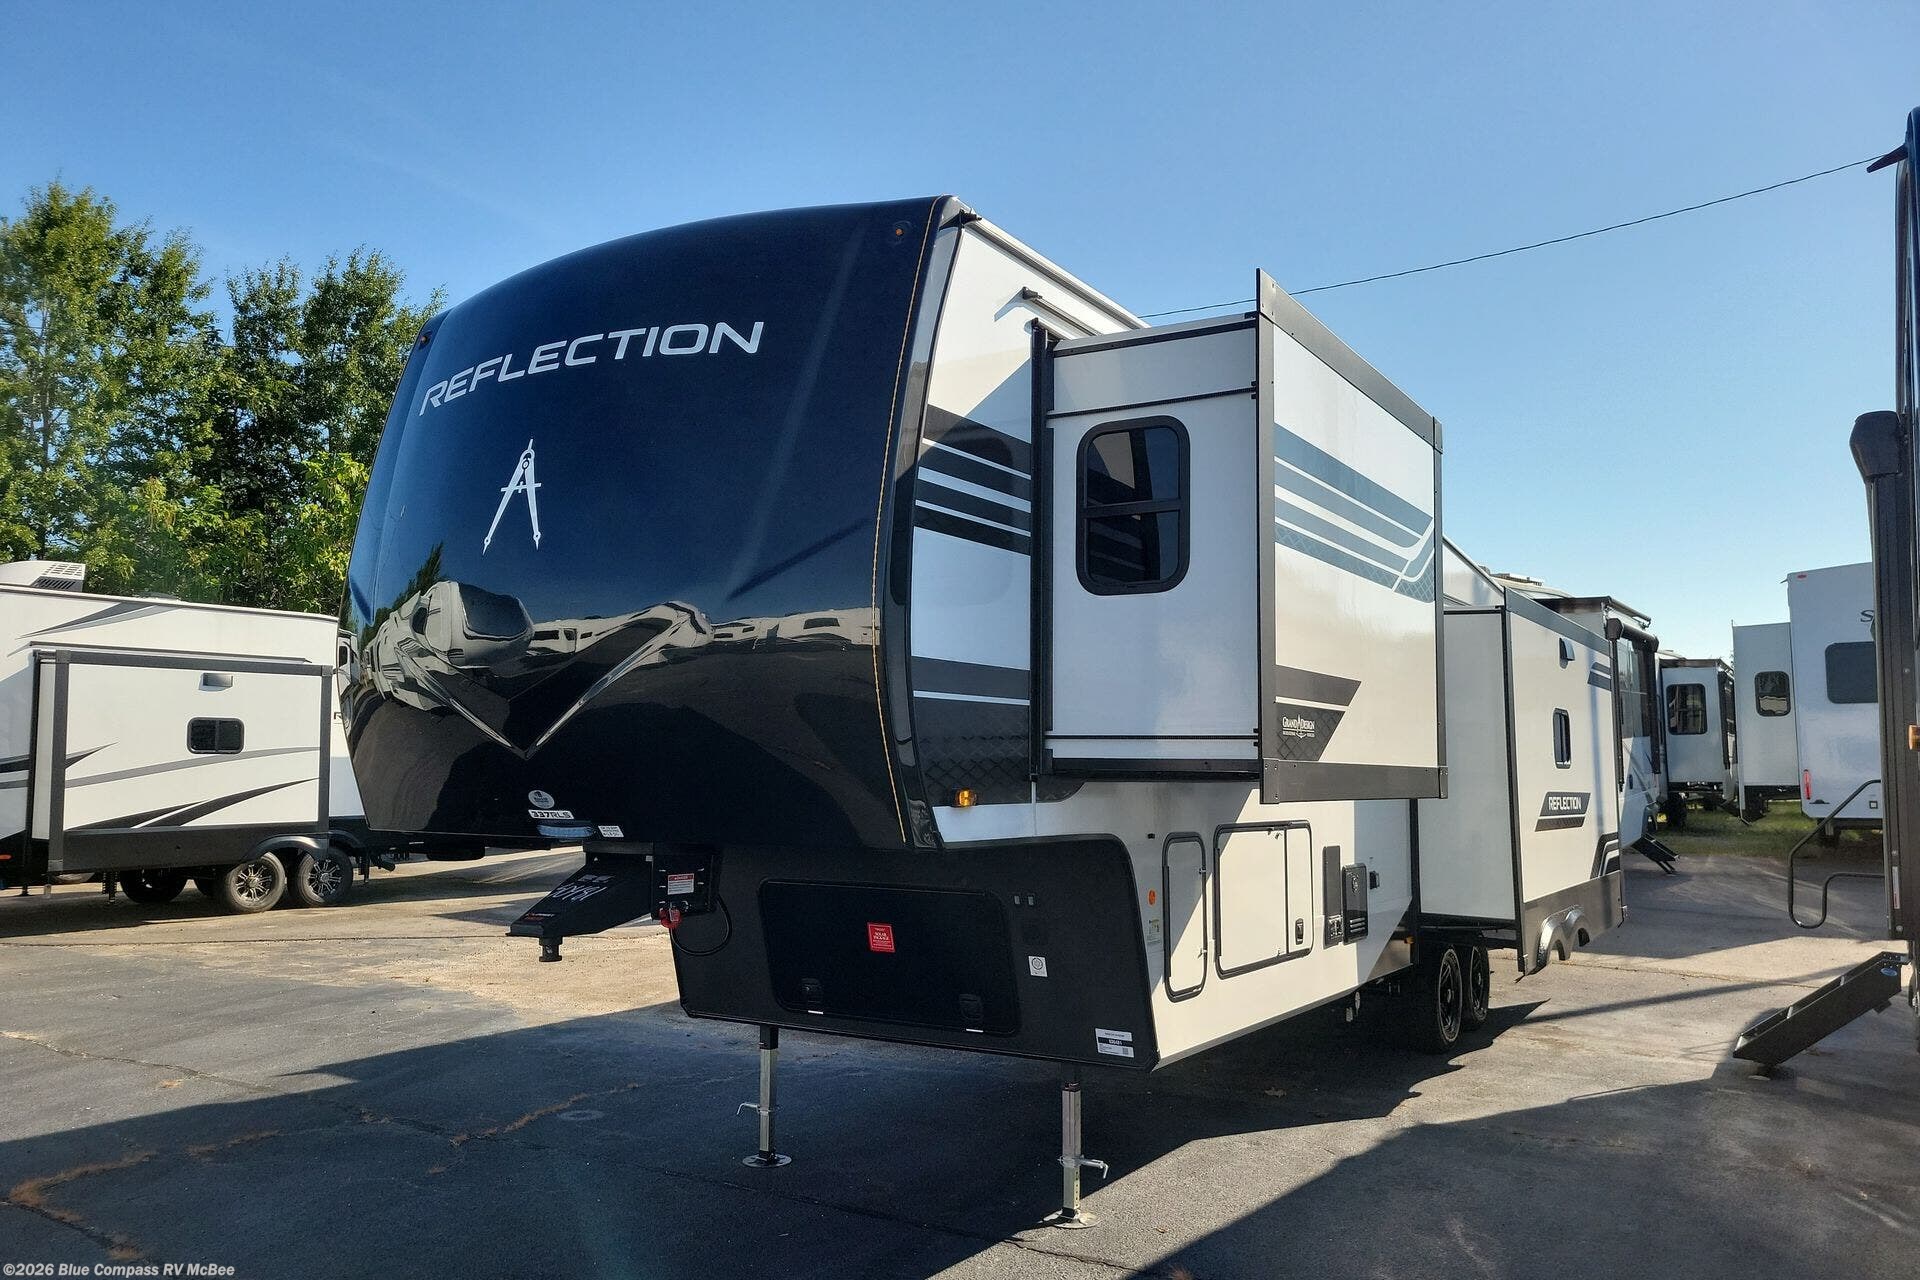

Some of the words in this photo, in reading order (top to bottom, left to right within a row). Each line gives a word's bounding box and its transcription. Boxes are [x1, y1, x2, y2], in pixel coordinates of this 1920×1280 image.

[419, 321, 764, 417] REFLECTION
[1282, 716, 1298, 729] GRAND
[1300, 718, 1315, 730] DESIGN
[1549, 796, 1581, 810] REFLECTION
